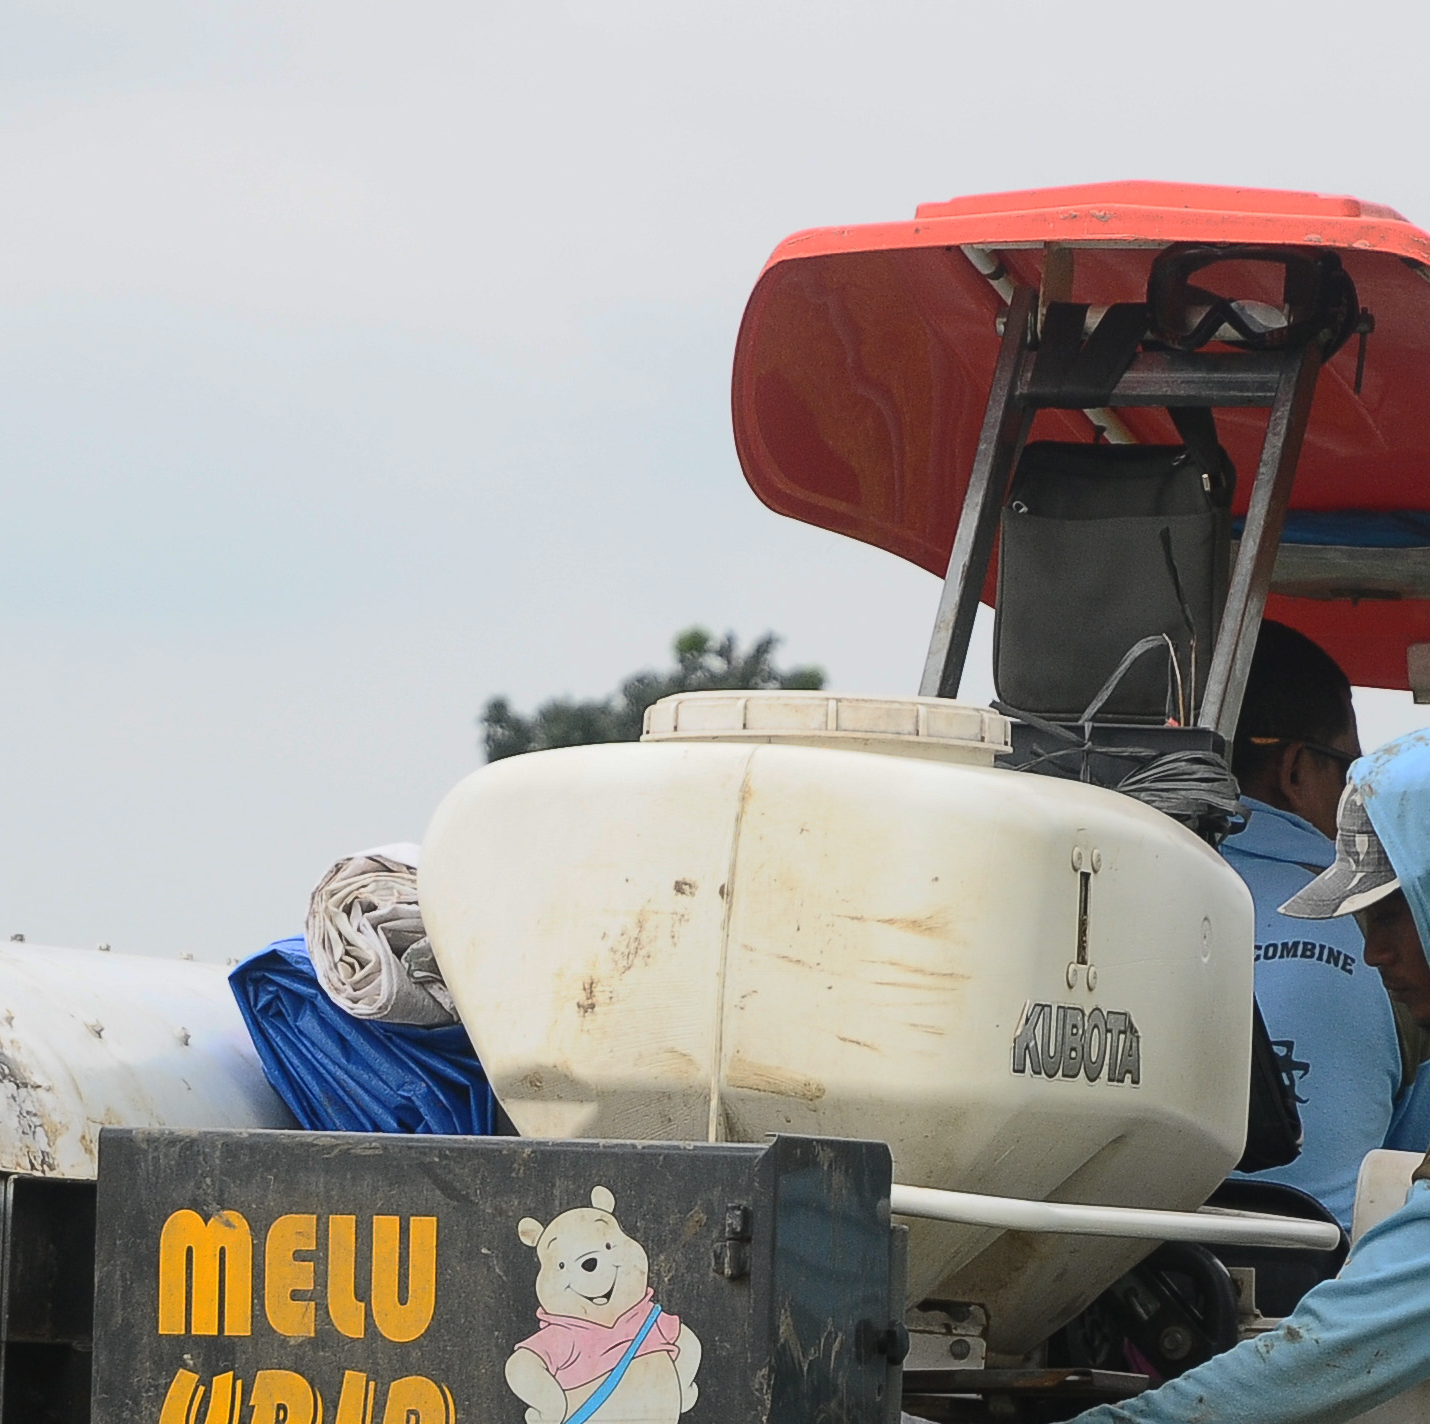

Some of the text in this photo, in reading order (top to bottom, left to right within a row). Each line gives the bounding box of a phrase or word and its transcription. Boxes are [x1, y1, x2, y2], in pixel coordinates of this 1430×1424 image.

[1253, 940, 1356, 976] COMBINE
[1012, 1002, 1141, 1085] KUBOTA
[157, 1208, 439, 1343] MELU
